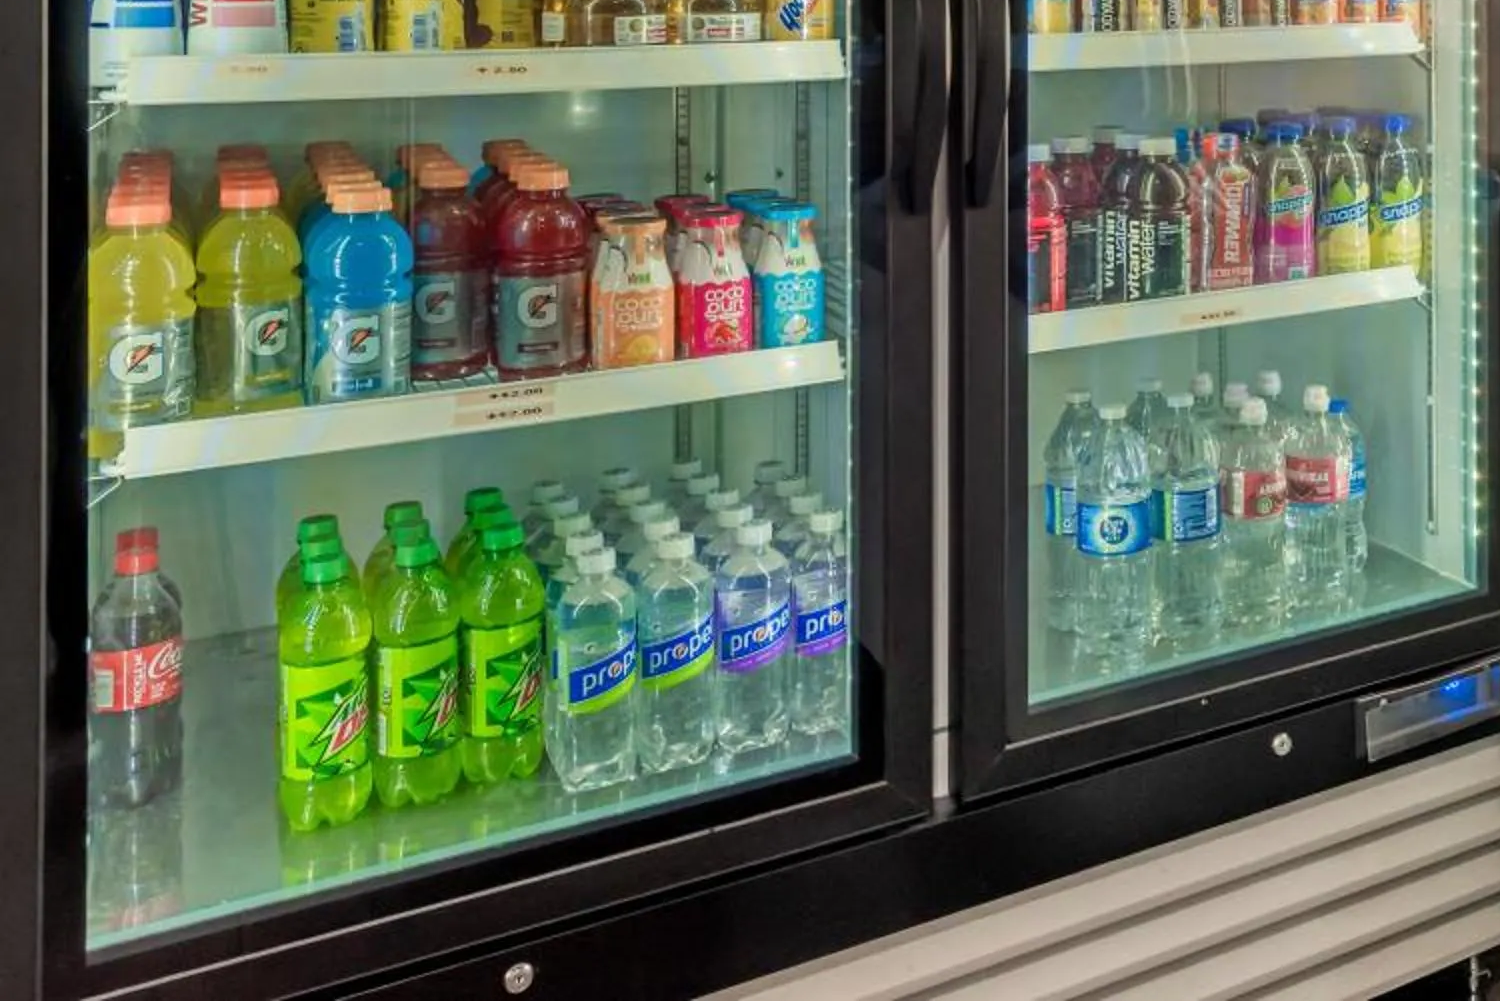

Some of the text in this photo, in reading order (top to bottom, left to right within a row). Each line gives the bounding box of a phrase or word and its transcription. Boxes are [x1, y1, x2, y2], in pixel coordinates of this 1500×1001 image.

[1104, 210, 1115, 288] vitamin
[1128, 220, 1140, 299] vitamin
[1140, 220, 1155, 275] water
[806, 606, 846, 640] pro
